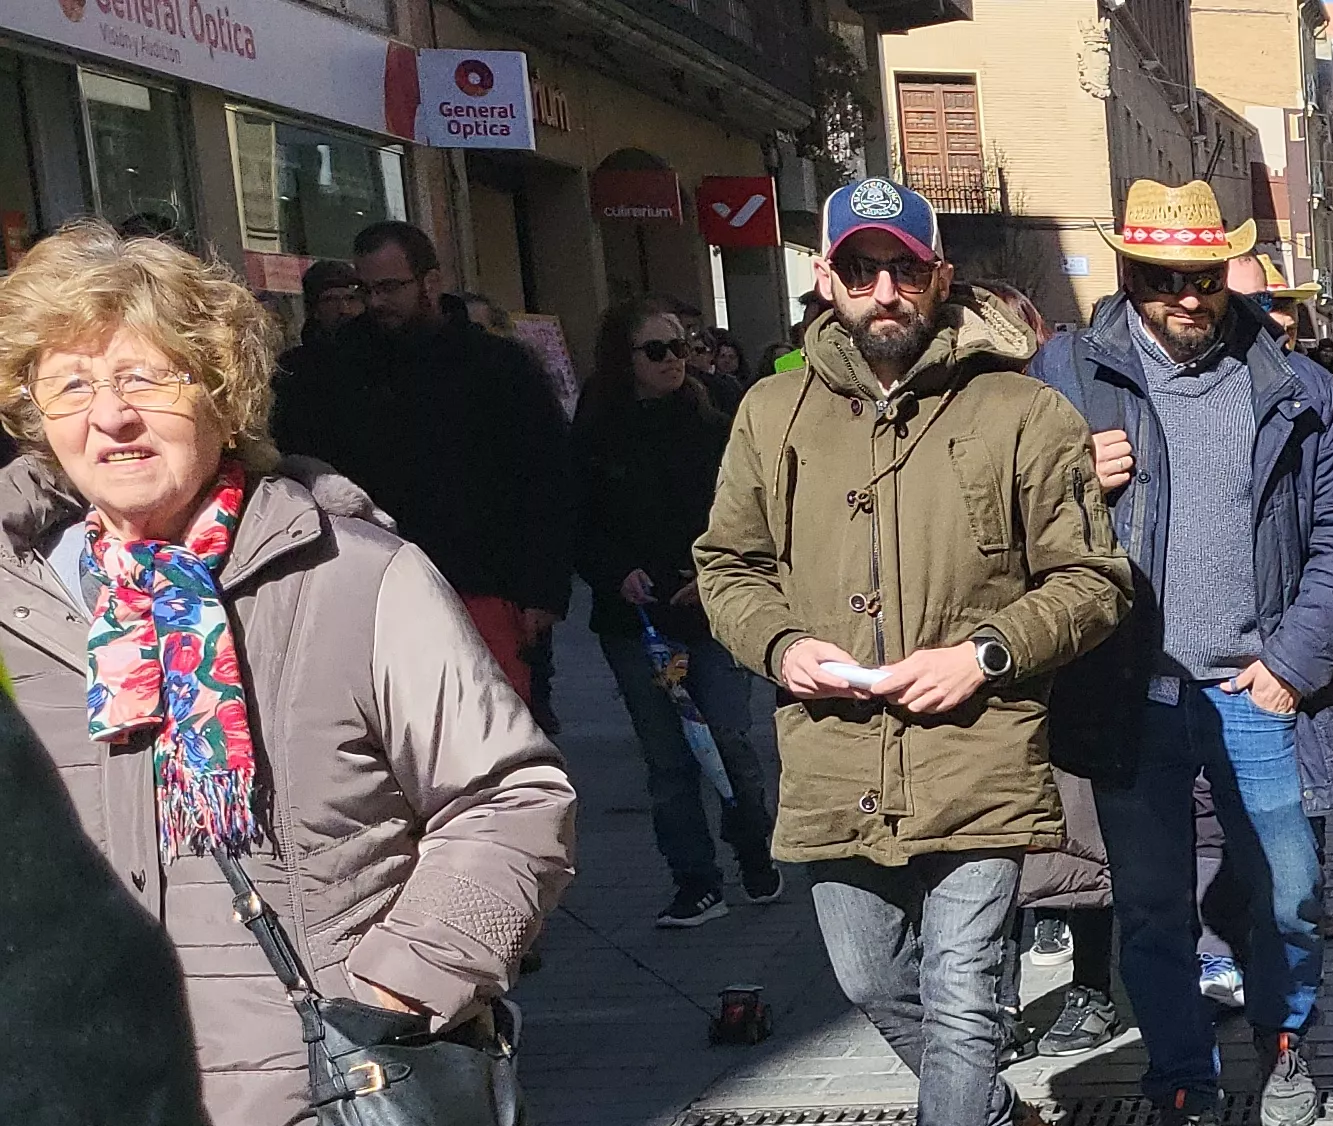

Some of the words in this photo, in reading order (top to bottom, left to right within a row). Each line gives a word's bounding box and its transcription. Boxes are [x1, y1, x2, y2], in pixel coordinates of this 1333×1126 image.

[188, 0, 257, 60] Optica
[439, 102, 516, 119] General
[447, 119, 511, 139] Optica
